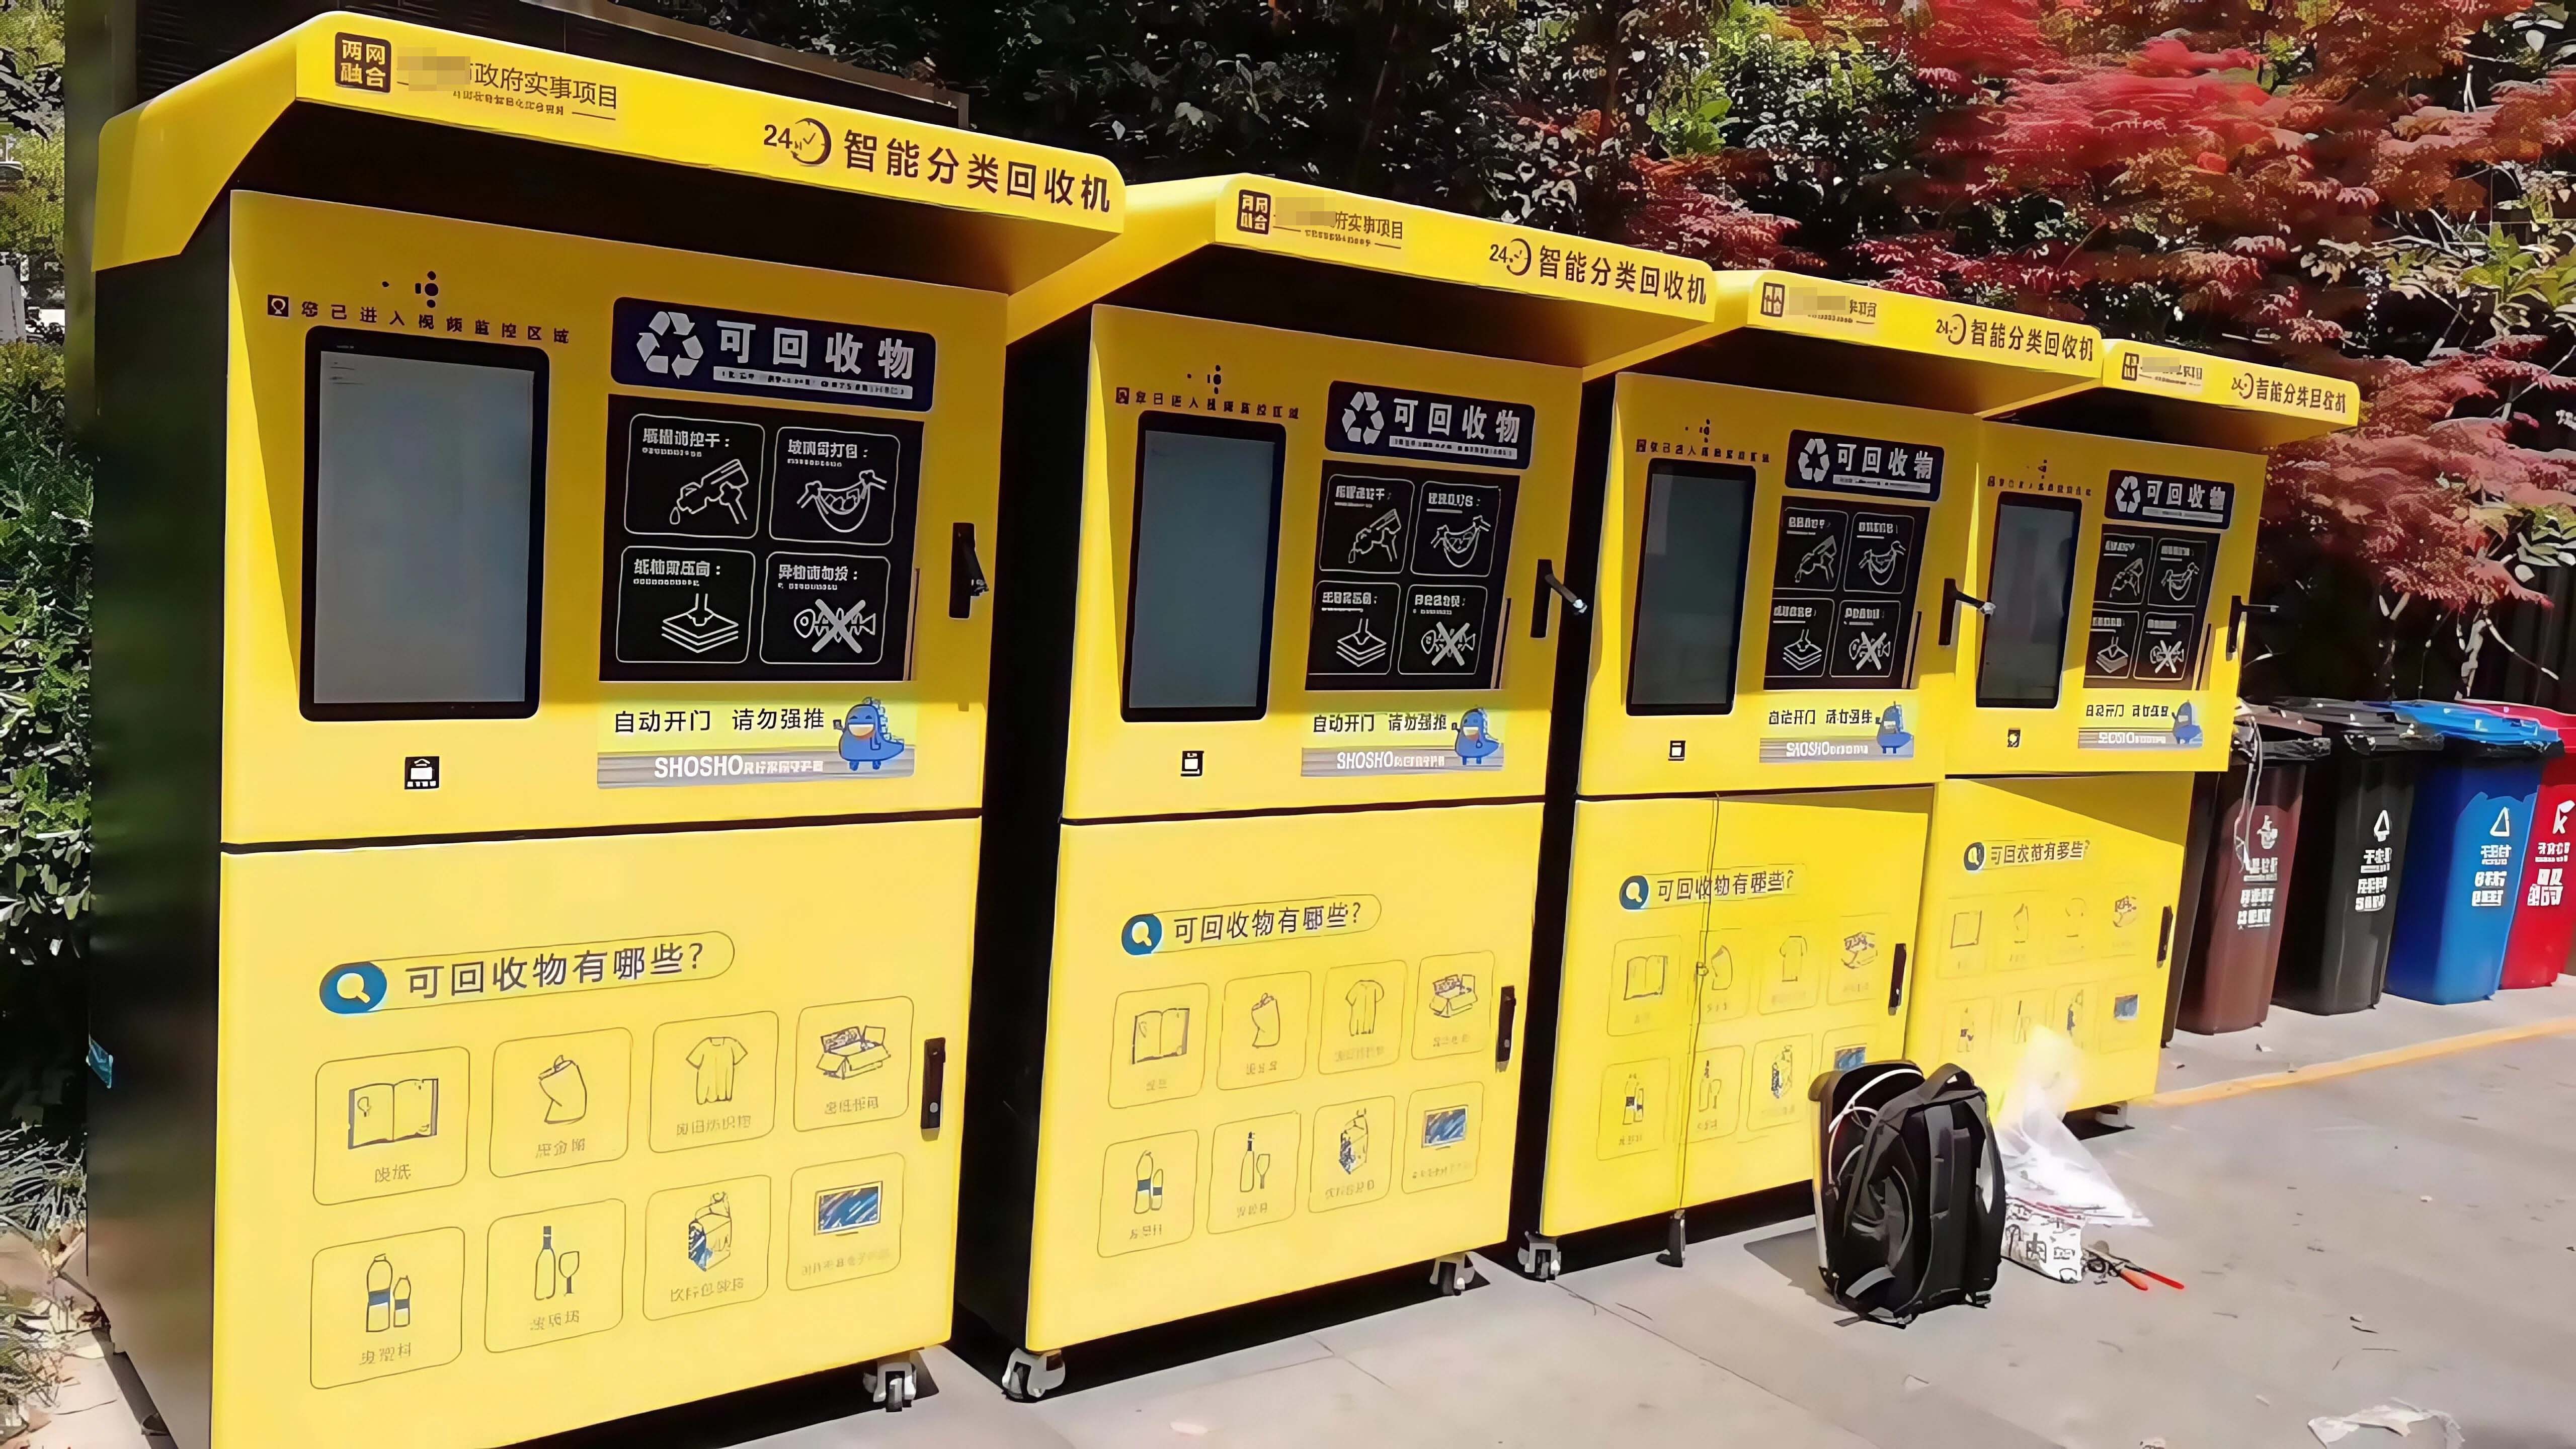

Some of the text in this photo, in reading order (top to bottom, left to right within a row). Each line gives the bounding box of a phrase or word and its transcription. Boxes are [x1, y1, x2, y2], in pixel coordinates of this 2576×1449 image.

[342, 39, 385, 65] 两网
[469, 62, 617, 110] 政府实事项目
[844, 129, 1110, 213] 智能分类回收机
[1540, 245, 1707, 305] 智能分类回收机
[716, 320, 914, 379] 可回收物
[1971, 319, 2094, 362] 智能分类回收机
[1394, 398, 1520, 443] 可回收物
[614, 707, 825, 733] 自动开门 请勿强推
[1313, 714, 1375, 733] 自动开门
[654, 755, 744, 778] SHOSHO
[1337, 751, 1393, 770] SHOSHO
[1174, 902, 1361, 944] 可回收物有哪些？
[405, 943, 703, 999] 可回收物有哪些？
